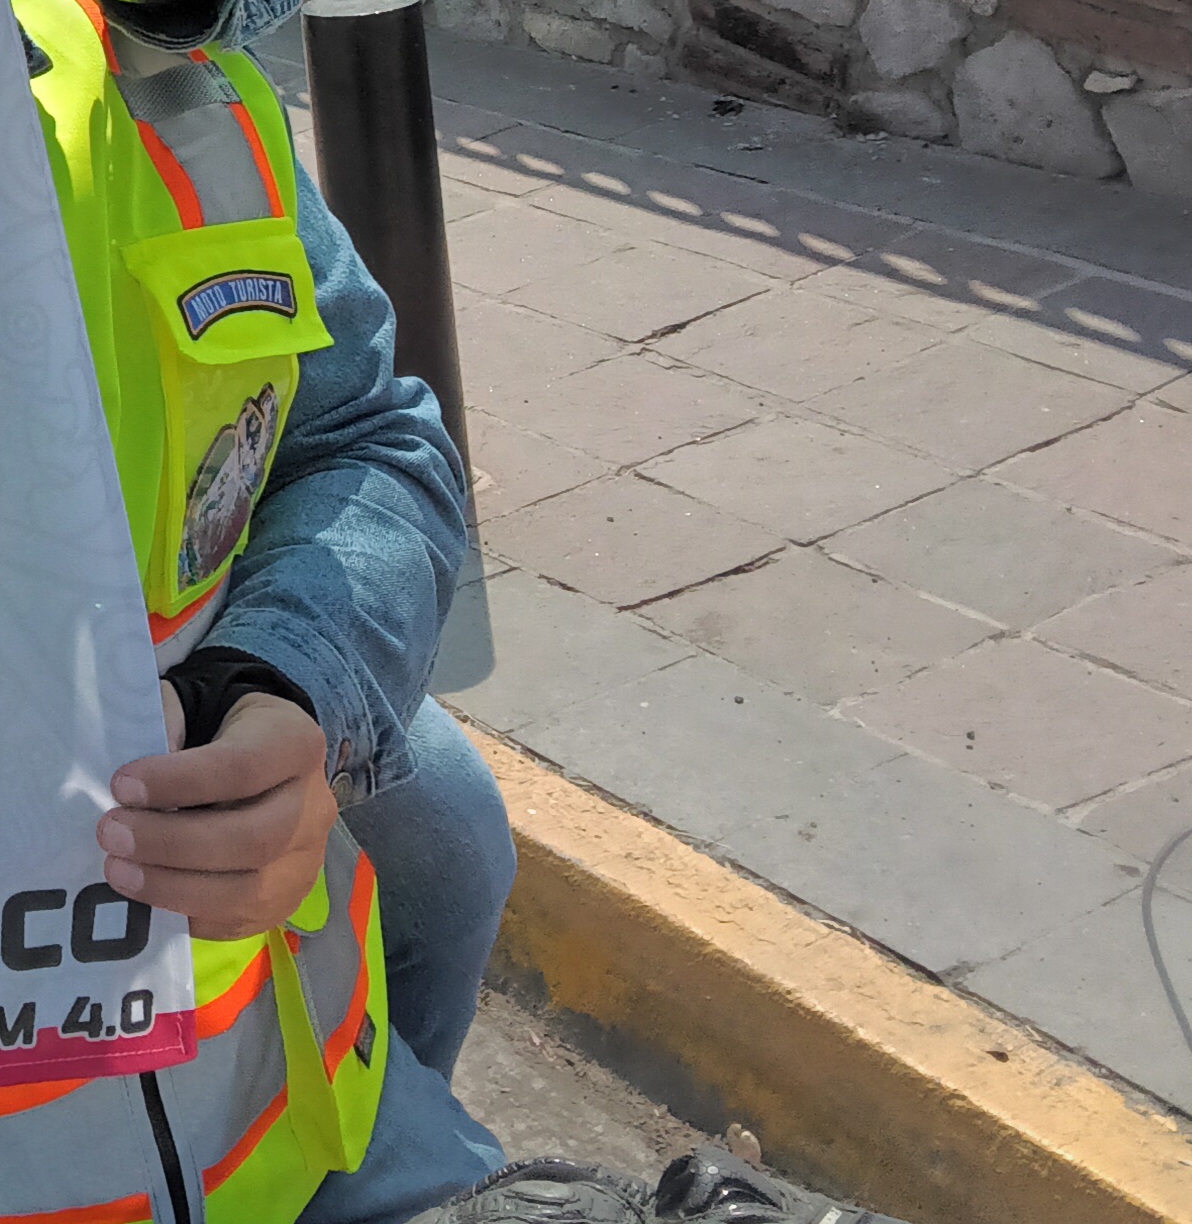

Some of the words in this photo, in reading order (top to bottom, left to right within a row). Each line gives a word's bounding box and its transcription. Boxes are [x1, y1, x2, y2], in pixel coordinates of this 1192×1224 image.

[191, 285, 227, 322] MOTO
[229, 278, 283, 304] TURISTA
[61, 990, 154, 1039] 4.0
